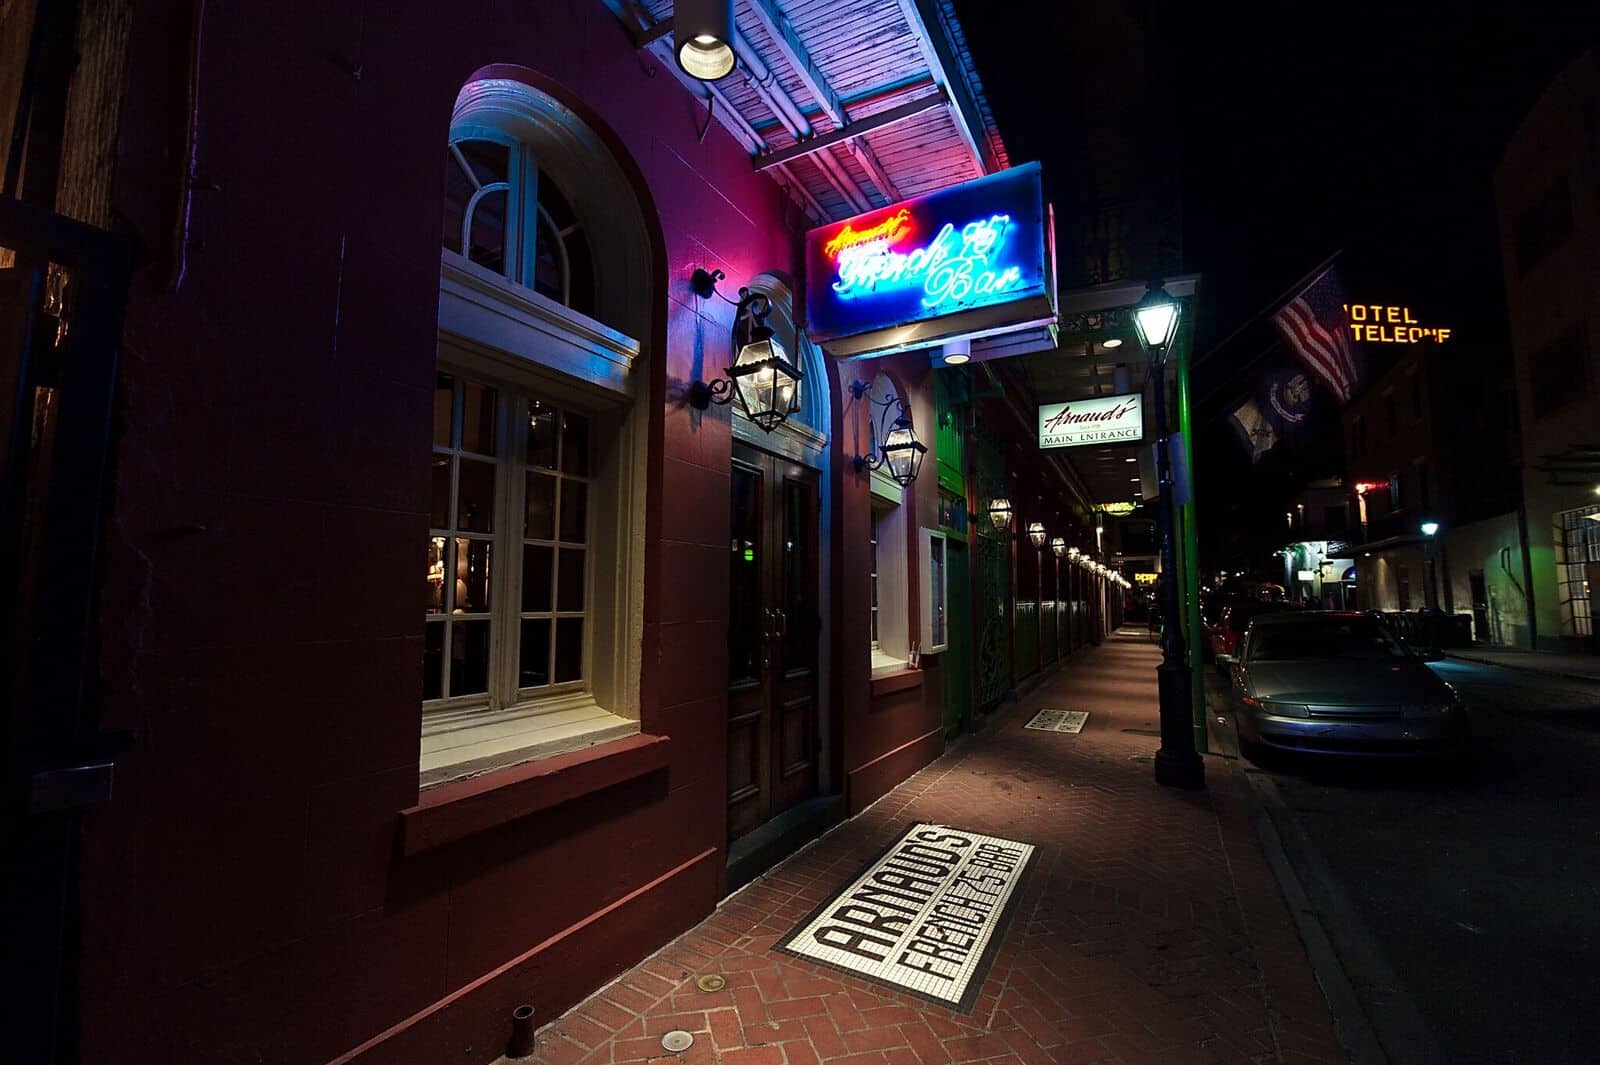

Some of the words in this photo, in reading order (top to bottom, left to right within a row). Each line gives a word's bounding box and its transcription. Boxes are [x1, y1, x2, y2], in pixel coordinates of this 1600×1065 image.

[833, 223, 952, 291] French
[922, 254, 1020, 306] Bar
[1343, 304, 1418, 324] OTEL
[1045, 398, 1136, 433] Arnaud's
[1044, 435, 1073, 445] MAIN
[1080, 429, 1138, 441] ENTRANCE
[968, 844, 1022, 872] BAR
[813, 831, 972, 962] ARNAUD'S
[951, 870, 1005, 896] 75
[896, 893, 994, 981] FRENCH
